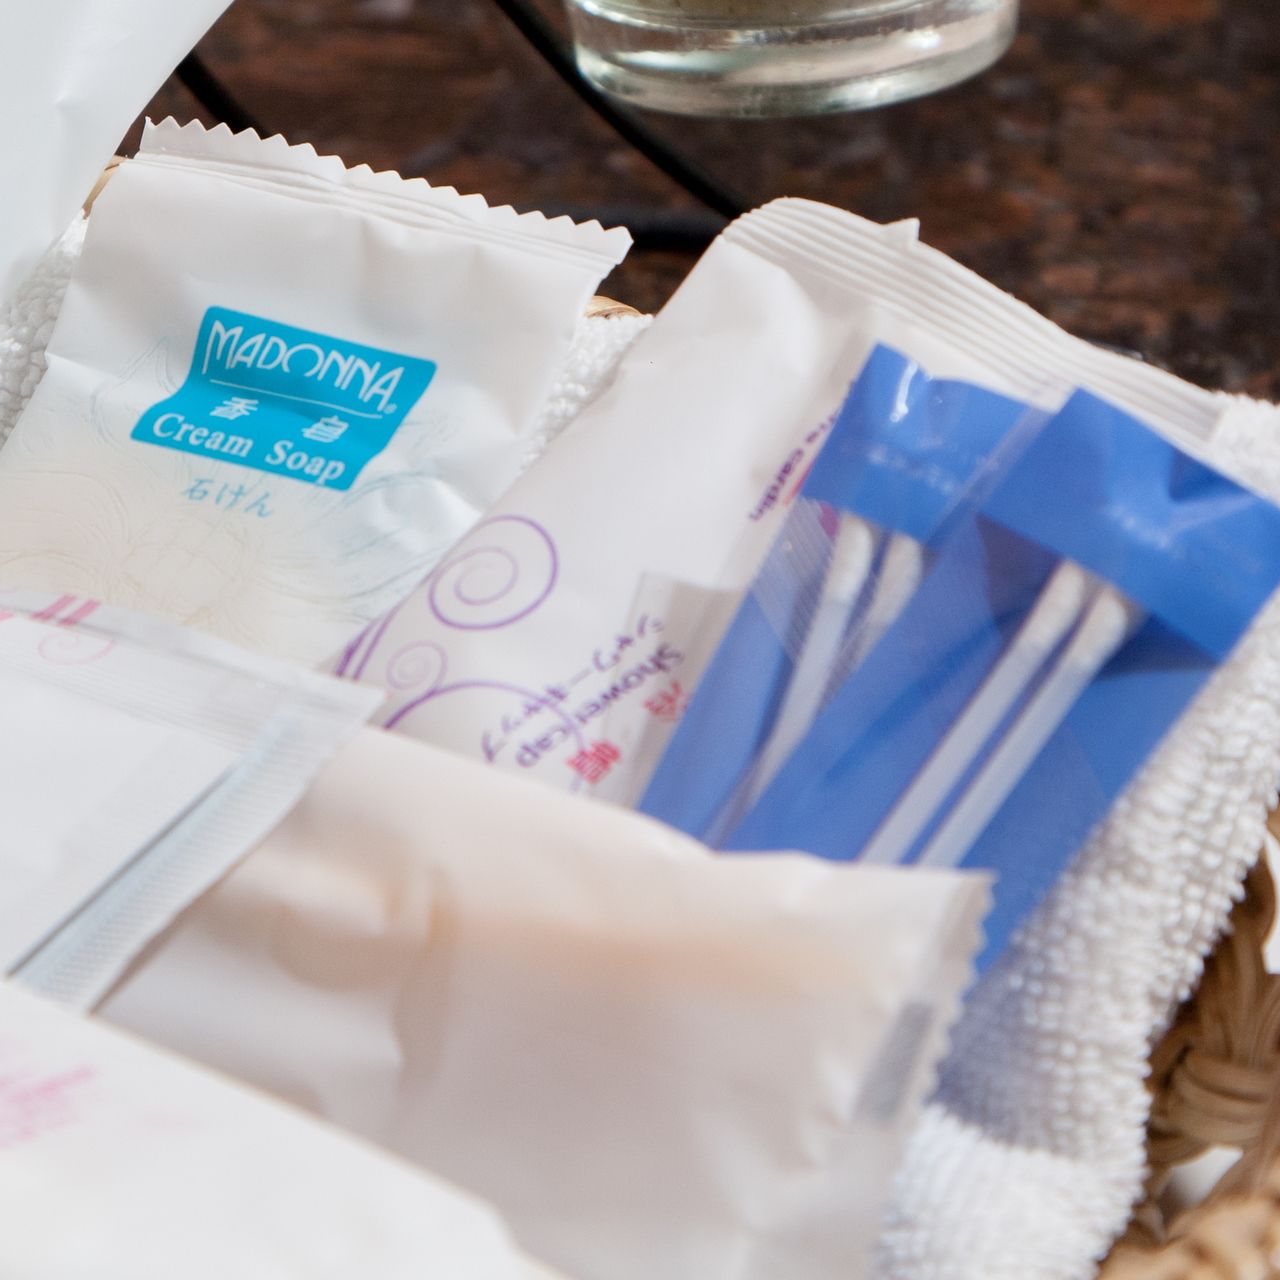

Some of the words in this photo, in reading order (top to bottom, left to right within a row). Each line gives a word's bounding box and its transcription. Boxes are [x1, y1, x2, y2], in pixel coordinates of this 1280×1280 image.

[202, 320, 406, 414] MADONNA
[152, 412, 255, 458] Cream
[264, 439, 347, 485] Soap
[180, 477, 276, 519] 石けん
[515, 722, 570, 768] cap
